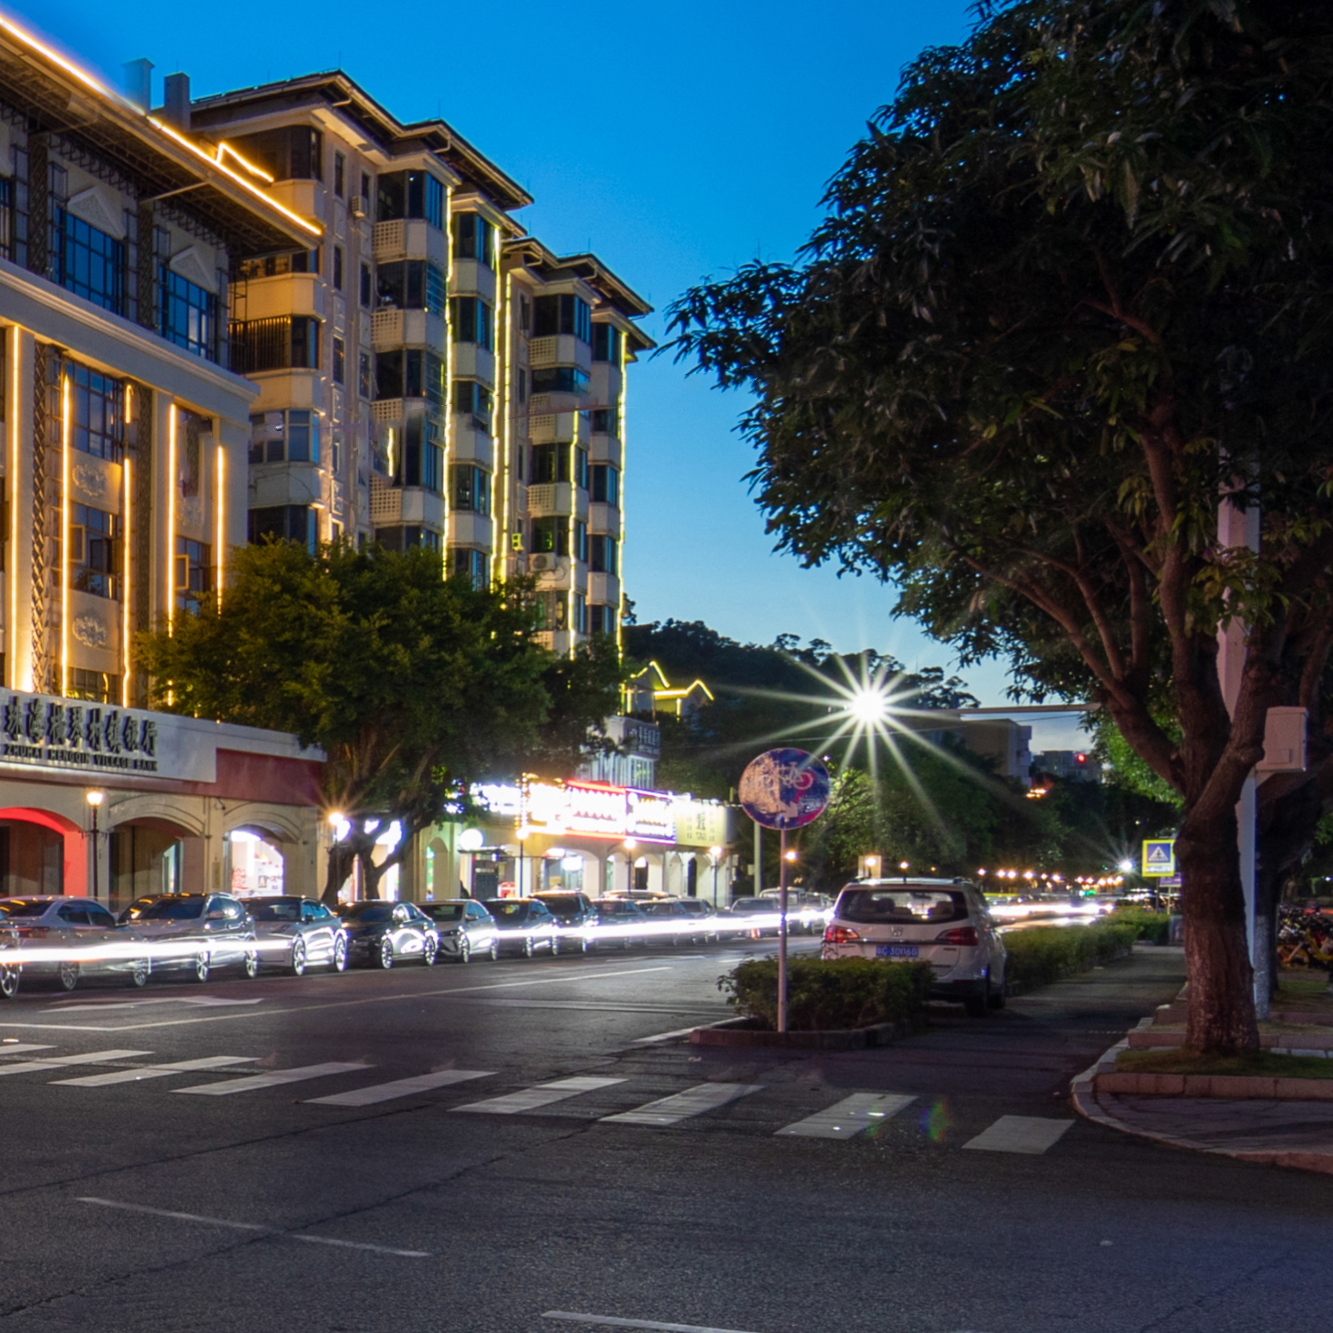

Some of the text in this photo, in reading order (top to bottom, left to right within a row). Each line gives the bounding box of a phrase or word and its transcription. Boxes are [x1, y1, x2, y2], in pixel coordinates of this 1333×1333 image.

[2, 743, 43, 759] ZHUHAI
[93, 754, 130, 769] VILLAGE
[133, 758, 158, 772] BANK
